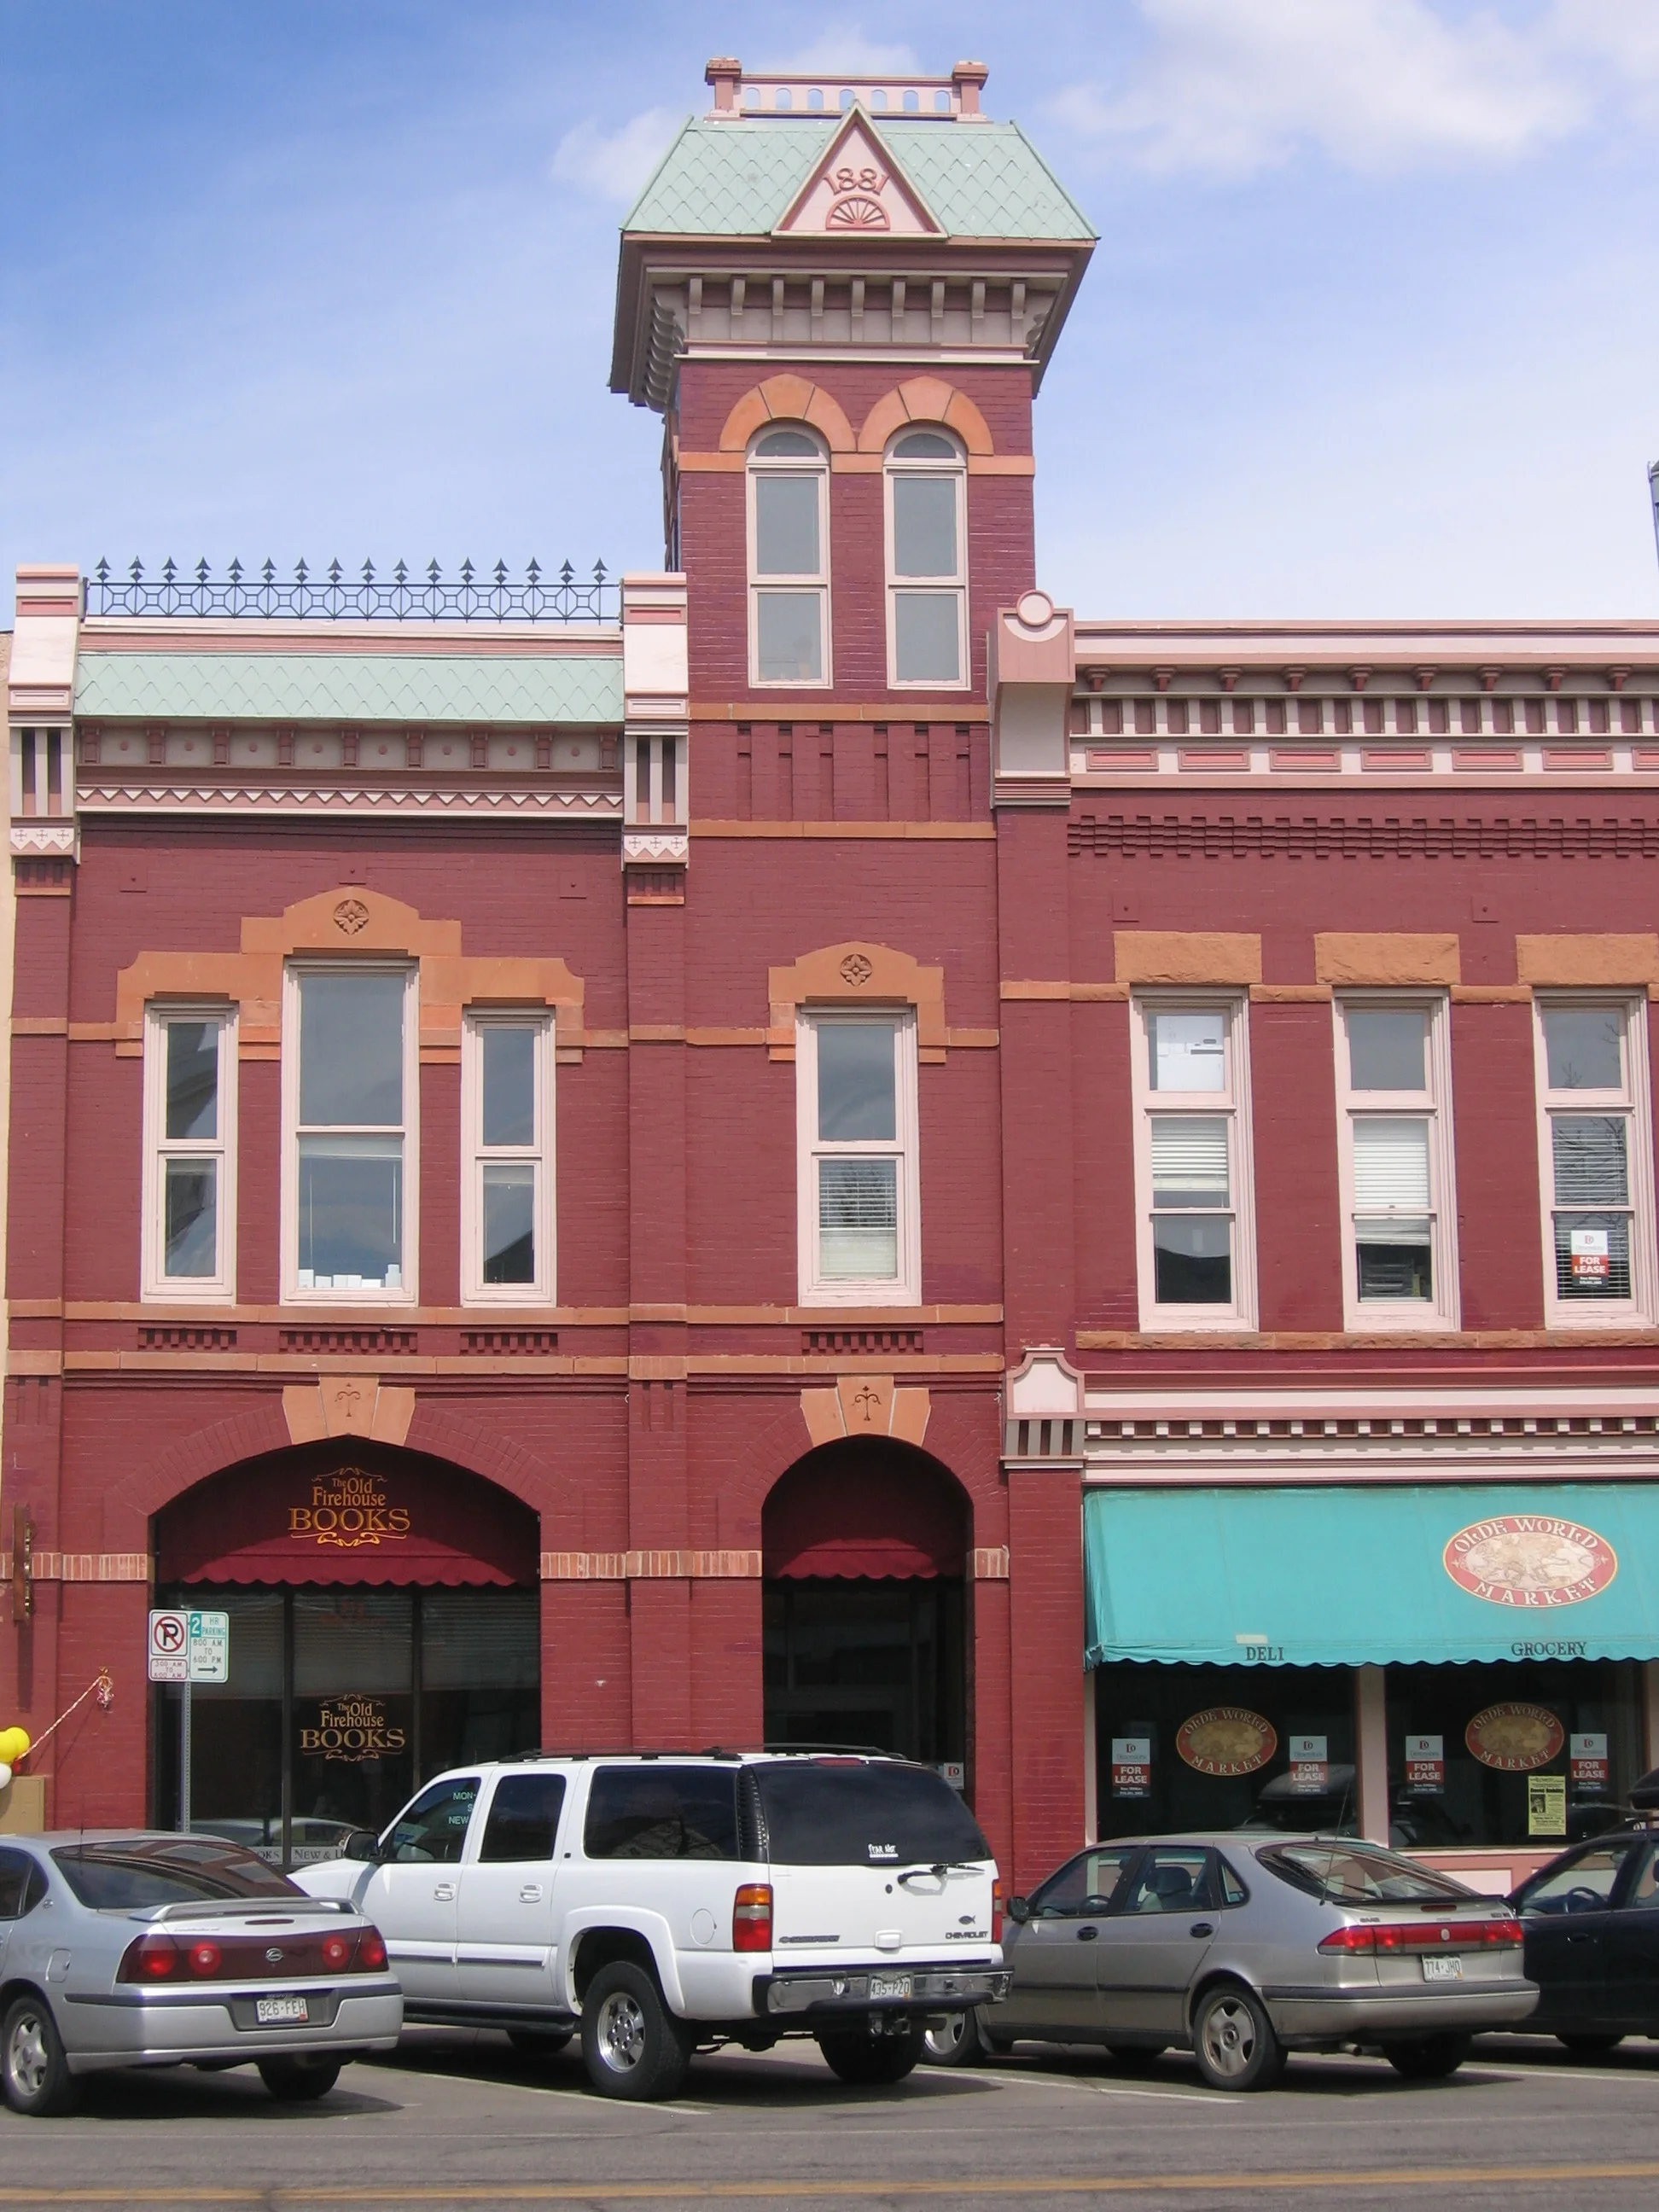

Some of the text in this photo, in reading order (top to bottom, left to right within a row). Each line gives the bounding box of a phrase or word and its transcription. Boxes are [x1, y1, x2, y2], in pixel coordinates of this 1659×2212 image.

[823, 167, 889, 196] 1881
[1580, 1256, 1600, 1265] FOR
[333, 1477, 372, 1493] The Old
[312, 1487, 386, 1506] Firehouse
[288, 1508, 410, 1531] BOOKS
[1514, 1518, 1598, 1549] WORLD
[1474, 1578, 1594, 1604] MARKET
[191, 1616, 200, 1634] 2
[201, 1627, 225, 1637] PARKING
[204, 1647, 212, 1656] TO
[1246, 1646, 1284, 1661] DELI
[1511, 1641, 1586, 1656] GROCERY
[337, 1703, 372, 1716] The Old
[1510, 1705, 1556, 1728] WORLD
[321, 1709, 384, 1727] Firehouse
[1221, 1709, 1268, 1732] WORLD
[300, 1728, 405, 1749] BOOKS
[1191, 1754, 1261, 1773] MARKET
[1480, 1748, 1550, 1768] MARKET
[1121, 1766, 1142, 1774] FOR
[1298, 1763, 1319, 1772] FOR
[1414, 1762, 1435, 1771] FOR
[1573, 1770, 1605, 1778] LEASE
[1115, 1775, 1148, 1784] LEASE
[1293, 1773, 1324, 1781] LEASE
[1409, 1772, 1441, 1780] LEASE
